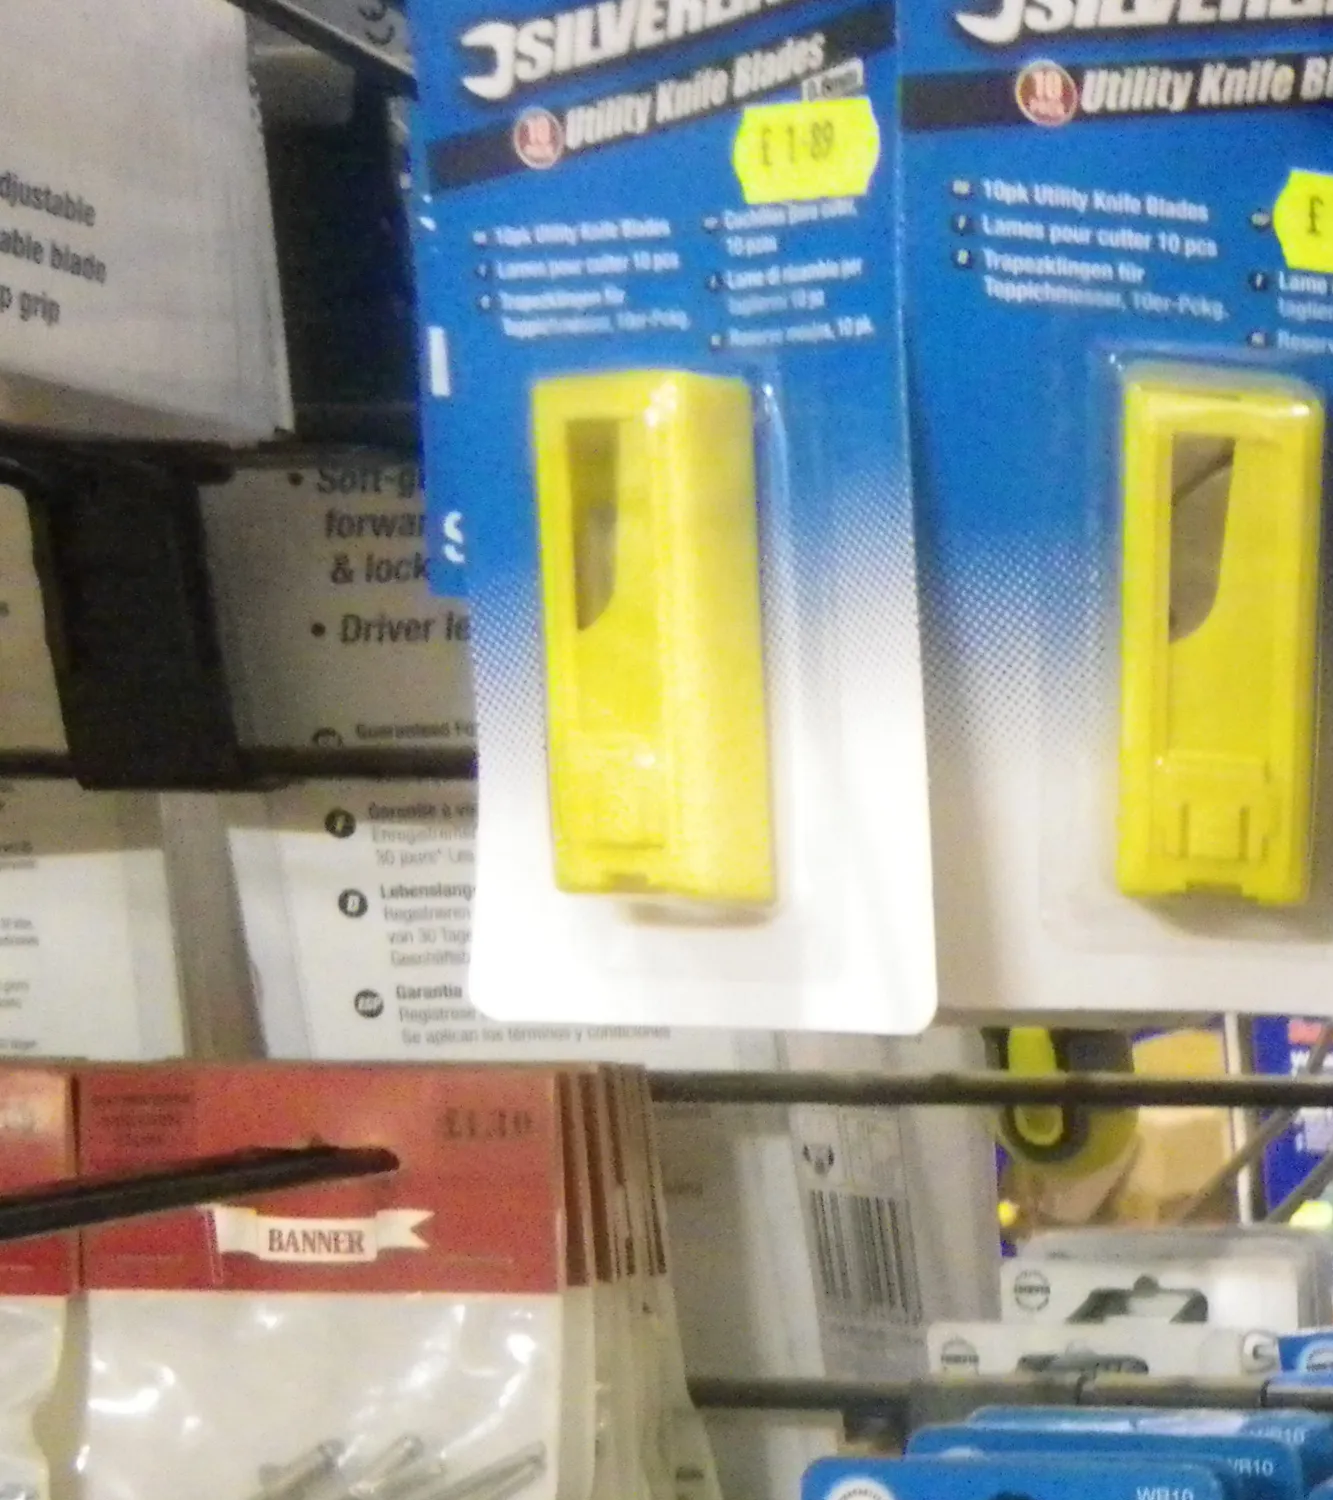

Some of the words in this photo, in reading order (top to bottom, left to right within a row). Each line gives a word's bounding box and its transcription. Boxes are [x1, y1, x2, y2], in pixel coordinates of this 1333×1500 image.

[565, 93, 653, 149] Utility
[655, 67, 729, 123] Knife
[732, 33, 826, 98] Blades
[1081, 66, 1193, 112] Utility
[1198, 59, 1295, 106] Knife
[340, 614, 433, 646] Driver
[267, 1225, 366, 1257] BANNER
